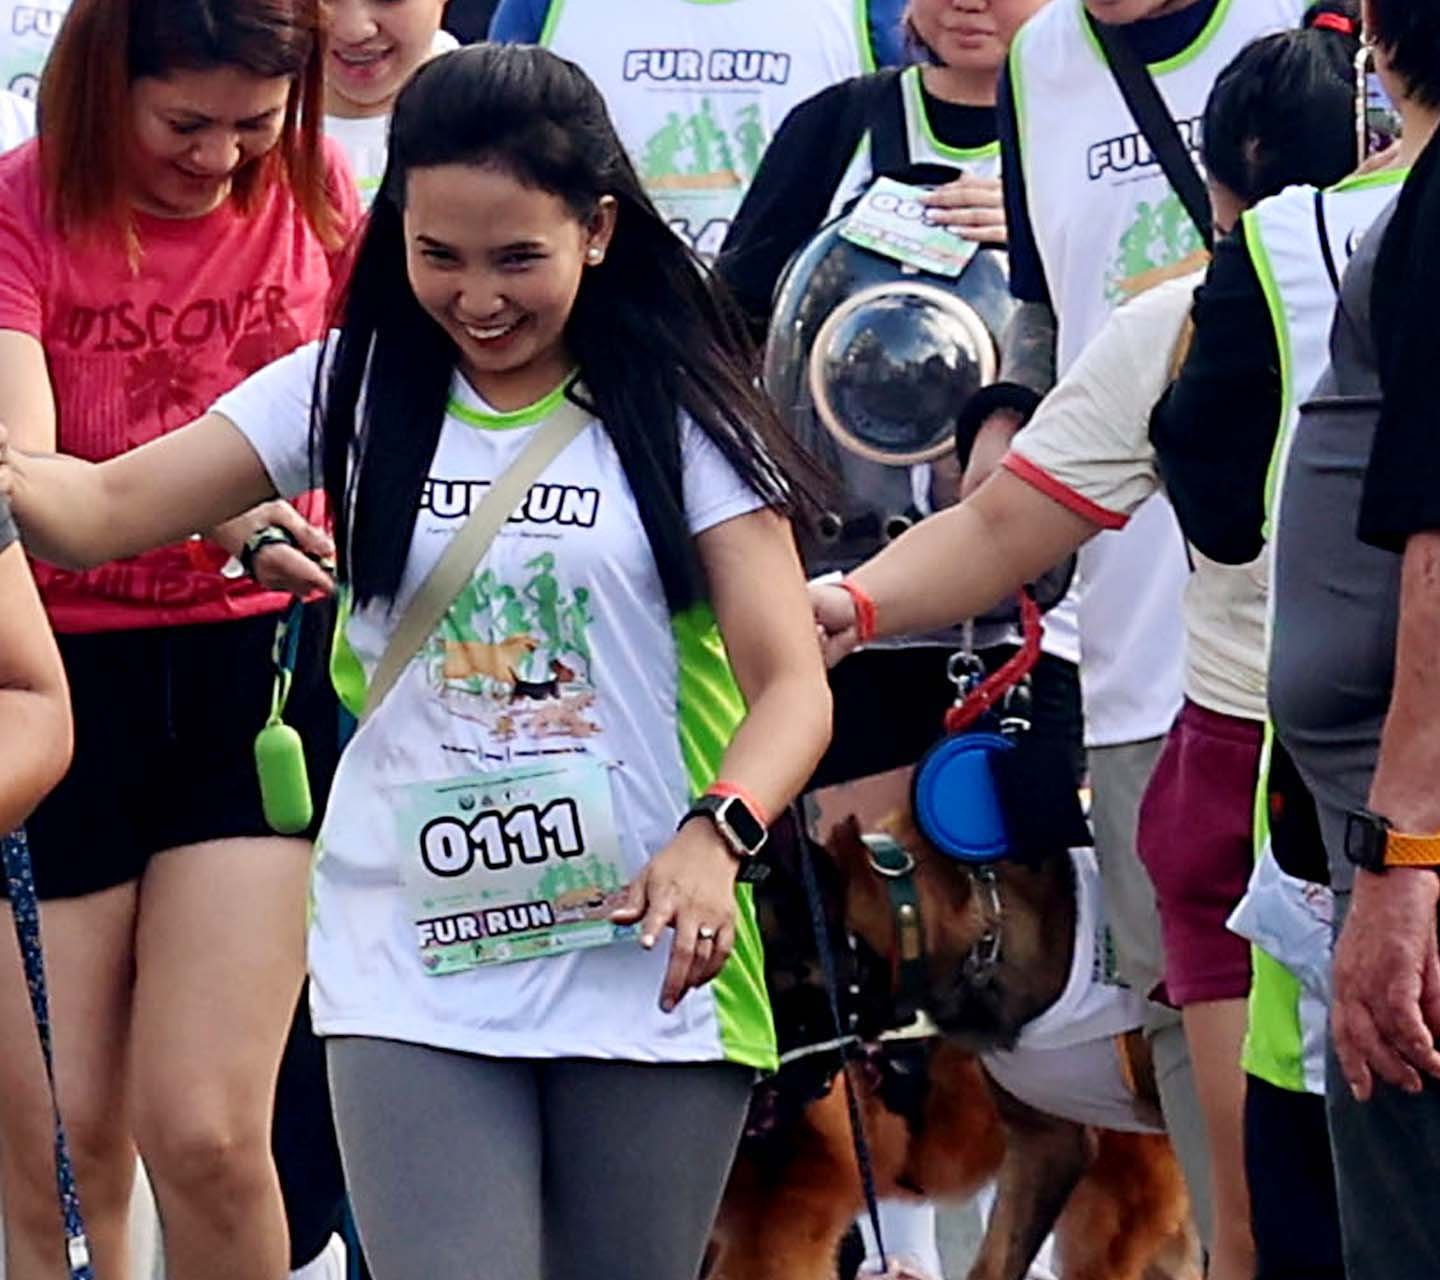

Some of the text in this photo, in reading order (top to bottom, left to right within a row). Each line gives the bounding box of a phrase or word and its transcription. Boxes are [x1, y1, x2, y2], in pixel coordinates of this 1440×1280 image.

[12, 6, 63, 37] FU
[623, 49, 790, 85] FUR RUN
[66, 285, 288, 353] DISCOVER
[420, 797, 585, 878] 0111
[416, 899, 556, 949] FUR RUN
